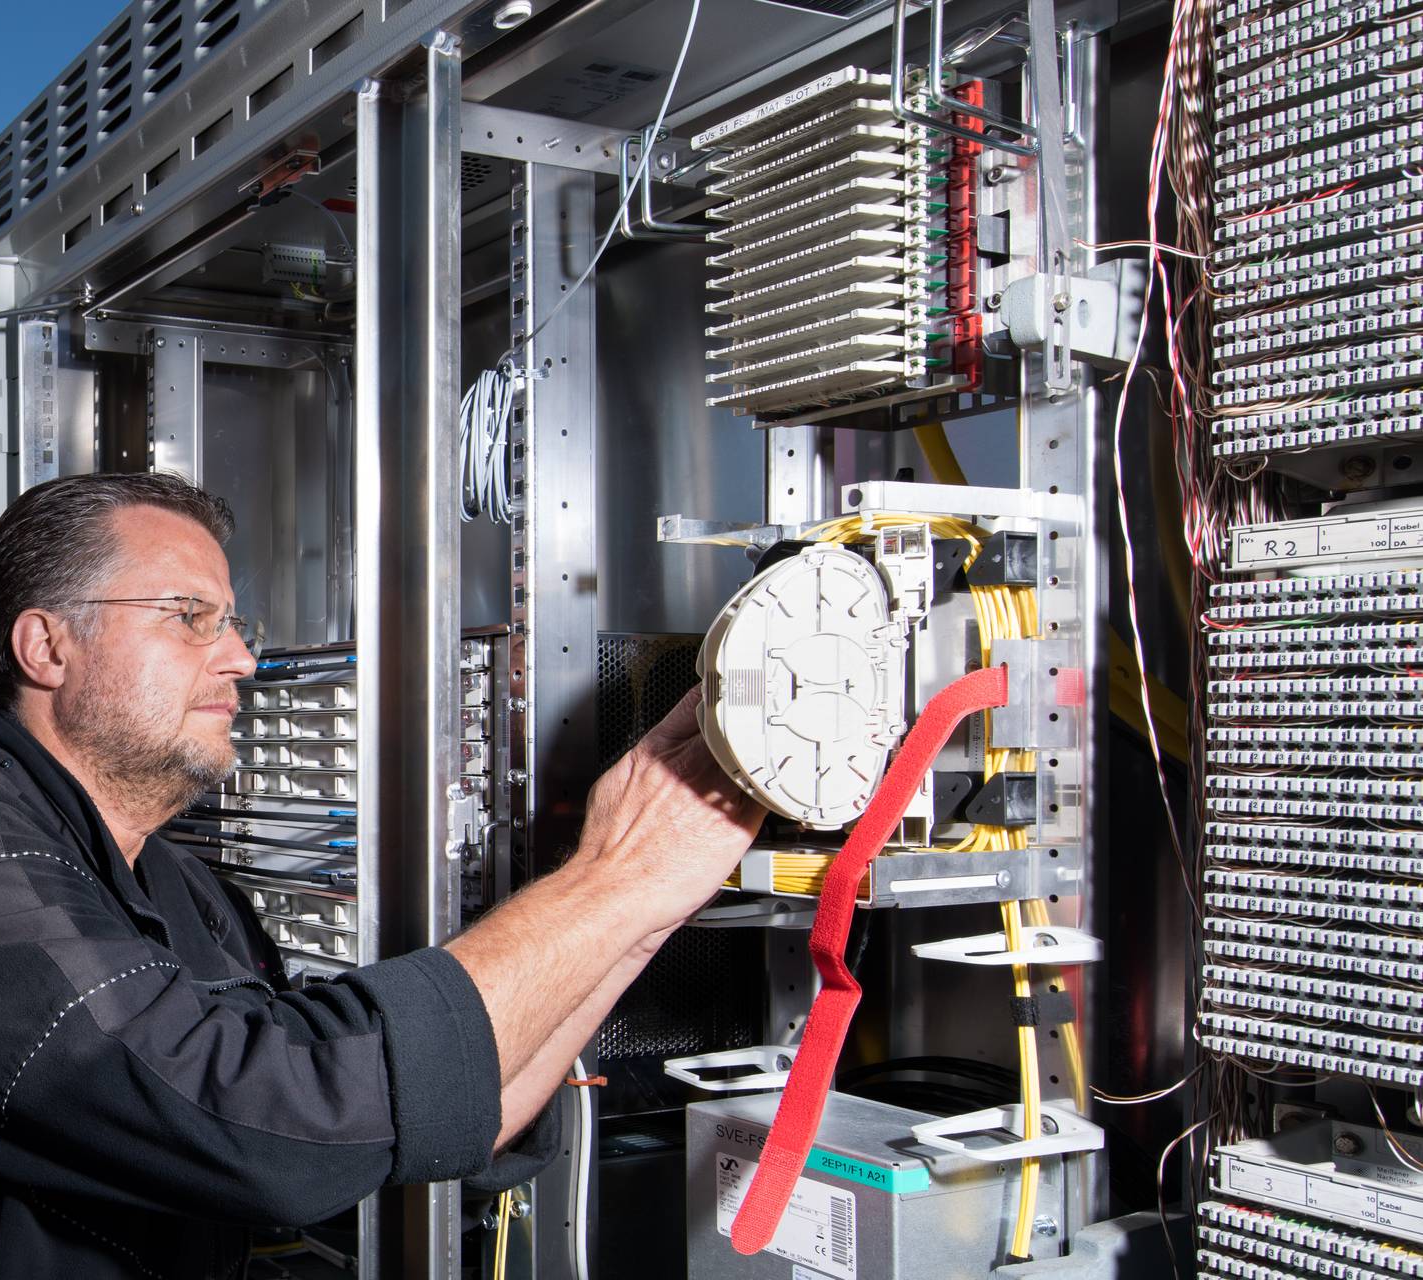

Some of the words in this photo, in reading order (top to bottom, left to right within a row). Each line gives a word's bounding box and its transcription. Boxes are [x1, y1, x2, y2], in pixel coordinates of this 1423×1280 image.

[698, 134, 714, 145] EVs
[816, 77, 833, 91] 1+2
[1394, 522, 1420, 531] Kabel
[1264, 540, 1278, 556] R
[1285, 540, 1297, 556] 2
[822, 1157, 863, 1176] 2EP1/F1
[1232, 1164, 1245, 1174] EVs
[866, 1168, 886, 1184] A21
[1264, 1178, 1273, 1192] 3
[1380, 1201, 1402, 1211] Kabel
[1361, 1210, 1375, 1218] 100
[1380, 1216, 1391, 1225] DA
